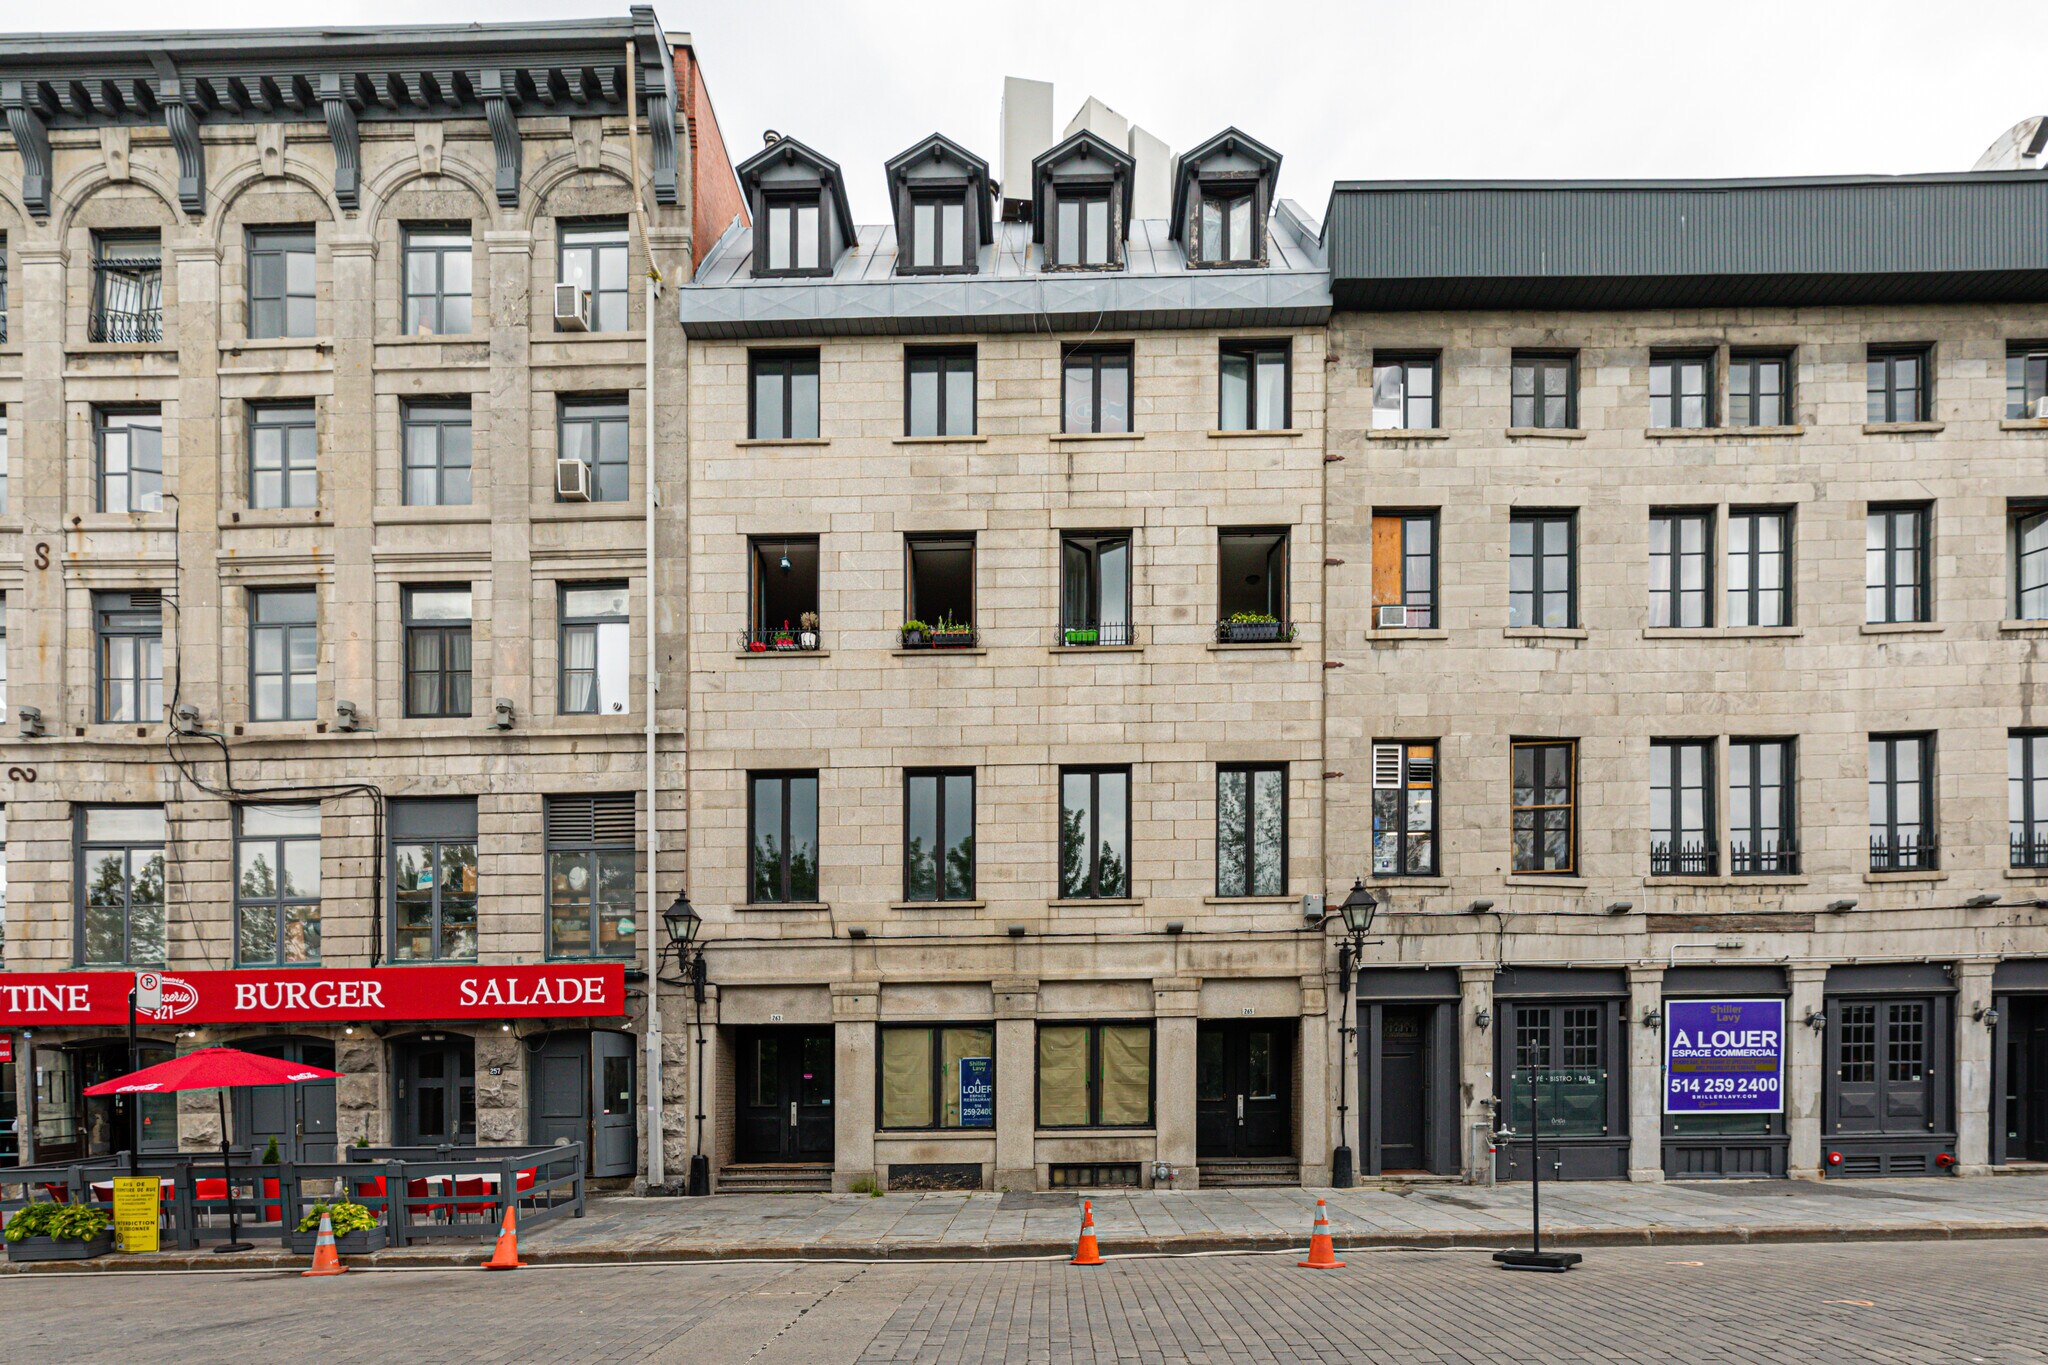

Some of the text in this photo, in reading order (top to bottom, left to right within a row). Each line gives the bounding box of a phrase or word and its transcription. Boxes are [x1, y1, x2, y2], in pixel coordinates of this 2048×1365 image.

[0, 984, 91, 1012] TINE
[234, 981, 385, 1009] BURGER
[460, 976, 606, 1006] SALADE
[153, 1004, 173, 1020] 321
[1710, 1004, 1743, 1014] Shiller
[1717, 1014, 1741, 1023] Lavy
[1673, 1028, 1778, 1048] À LOUER
[1672, 1048, 1778, 1057] ESPACE COMMERCIAL
[1671, 1077, 1778, 1093] 514 259 2400
